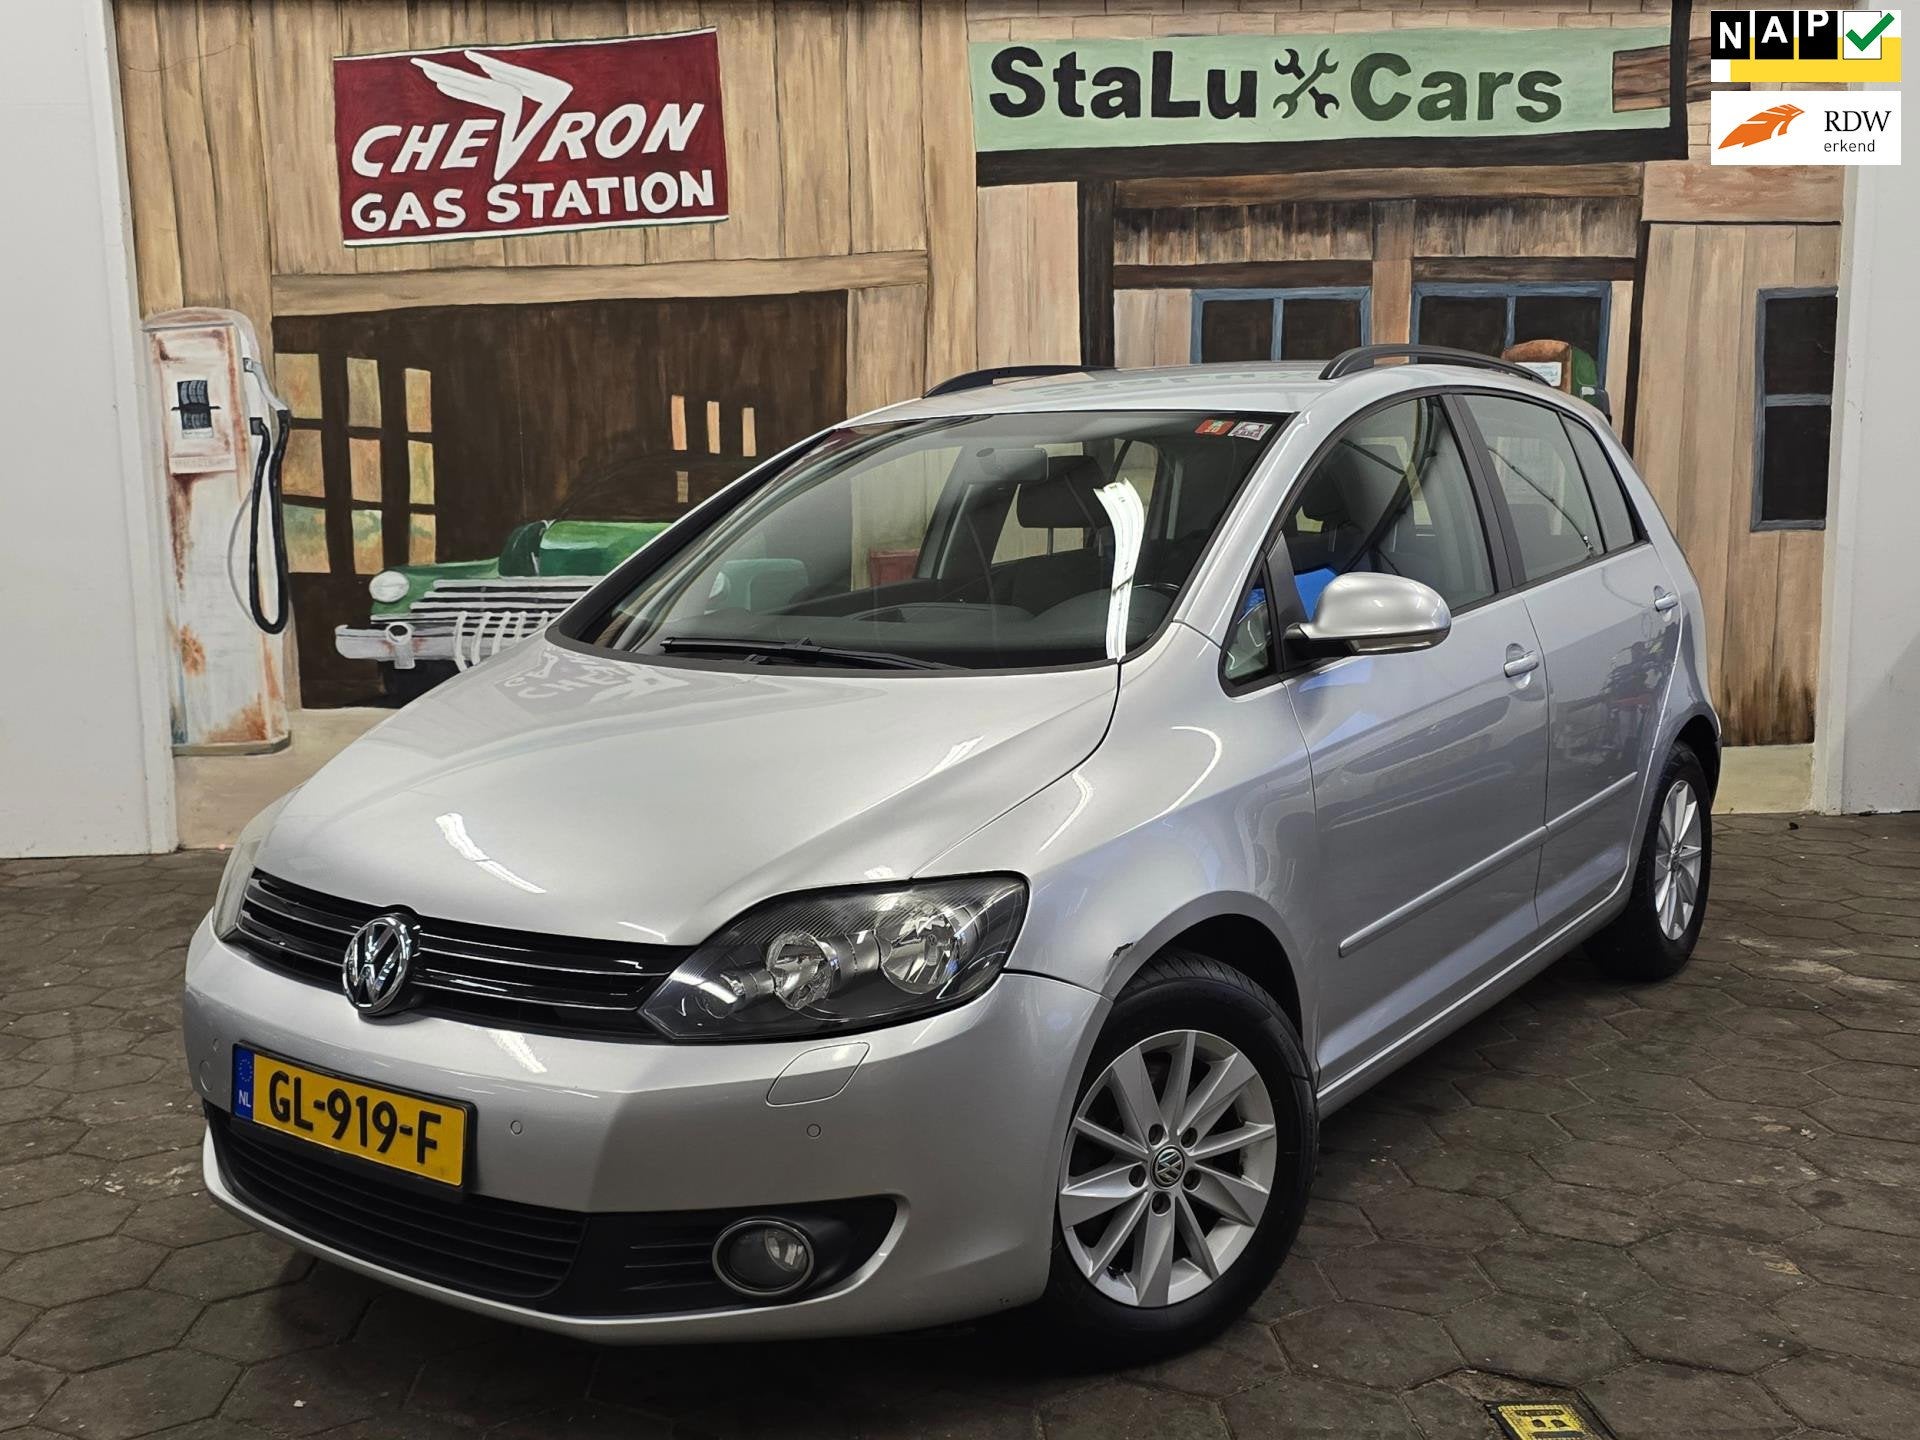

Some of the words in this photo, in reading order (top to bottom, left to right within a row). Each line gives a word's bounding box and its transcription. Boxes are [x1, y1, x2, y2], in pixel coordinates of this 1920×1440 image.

[989, 46, 1258, 119] StaLu
[1350, 52, 1563, 122] Cars
[351, 92, 705, 181] CHEVRON
[351, 188, 467, 232] GAS
[487, 169, 714, 223] STATION
[238, 1089, 252, 1108] NL
[269, 1070, 442, 1165] GL-919-F
